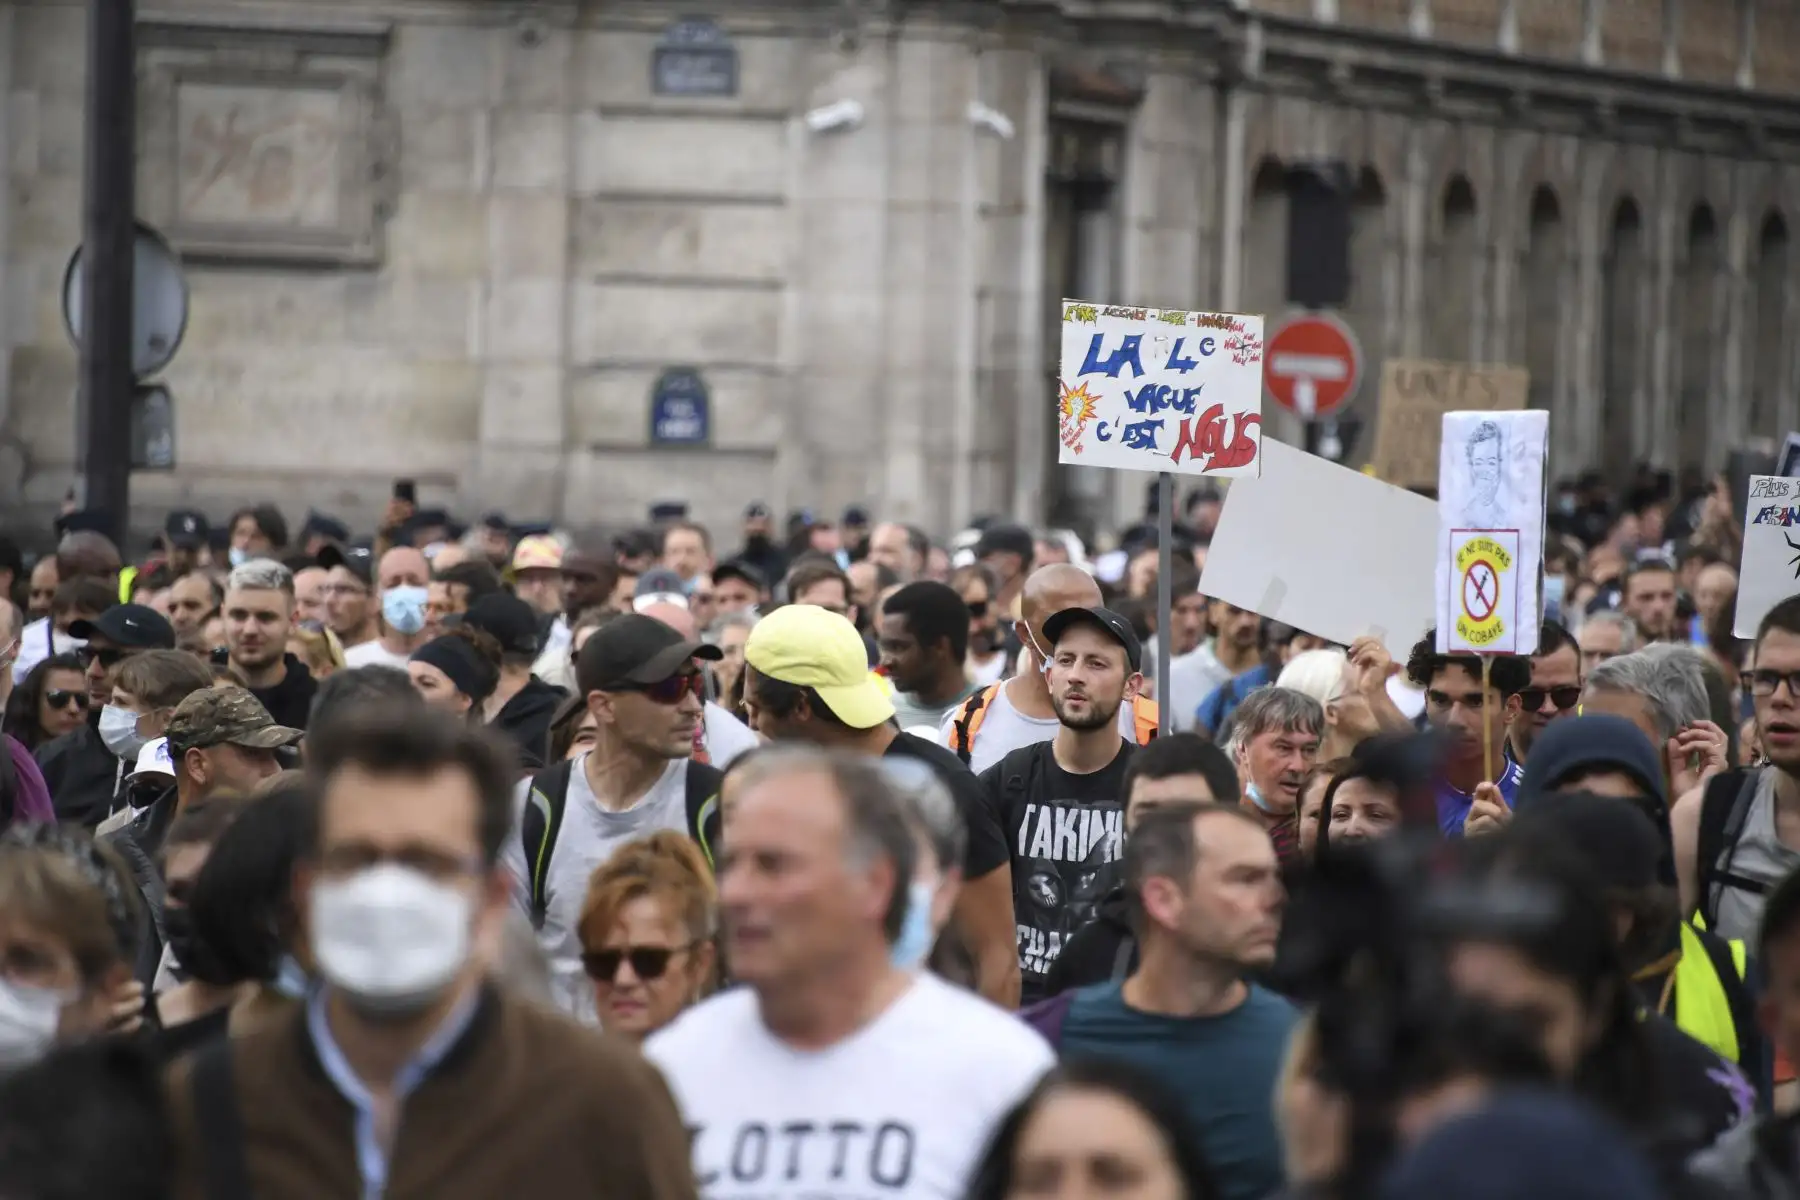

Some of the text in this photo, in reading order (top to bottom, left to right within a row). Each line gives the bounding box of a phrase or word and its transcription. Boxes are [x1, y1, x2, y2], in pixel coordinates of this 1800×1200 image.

[1077, 333, 1147, 378] LA
[1123, 383, 1206, 415] VAGUE
[1170, 403, 1264, 473] NOUS
[1466, 543, 1475, 555] NE
[1477, 539, 1494, 553] SUIS
[1495, 546, 1511, 568] PAS
[1457, 621, 1504, 643] UN COBAYE
[1018, 803, 1125, 864] TAKIN
